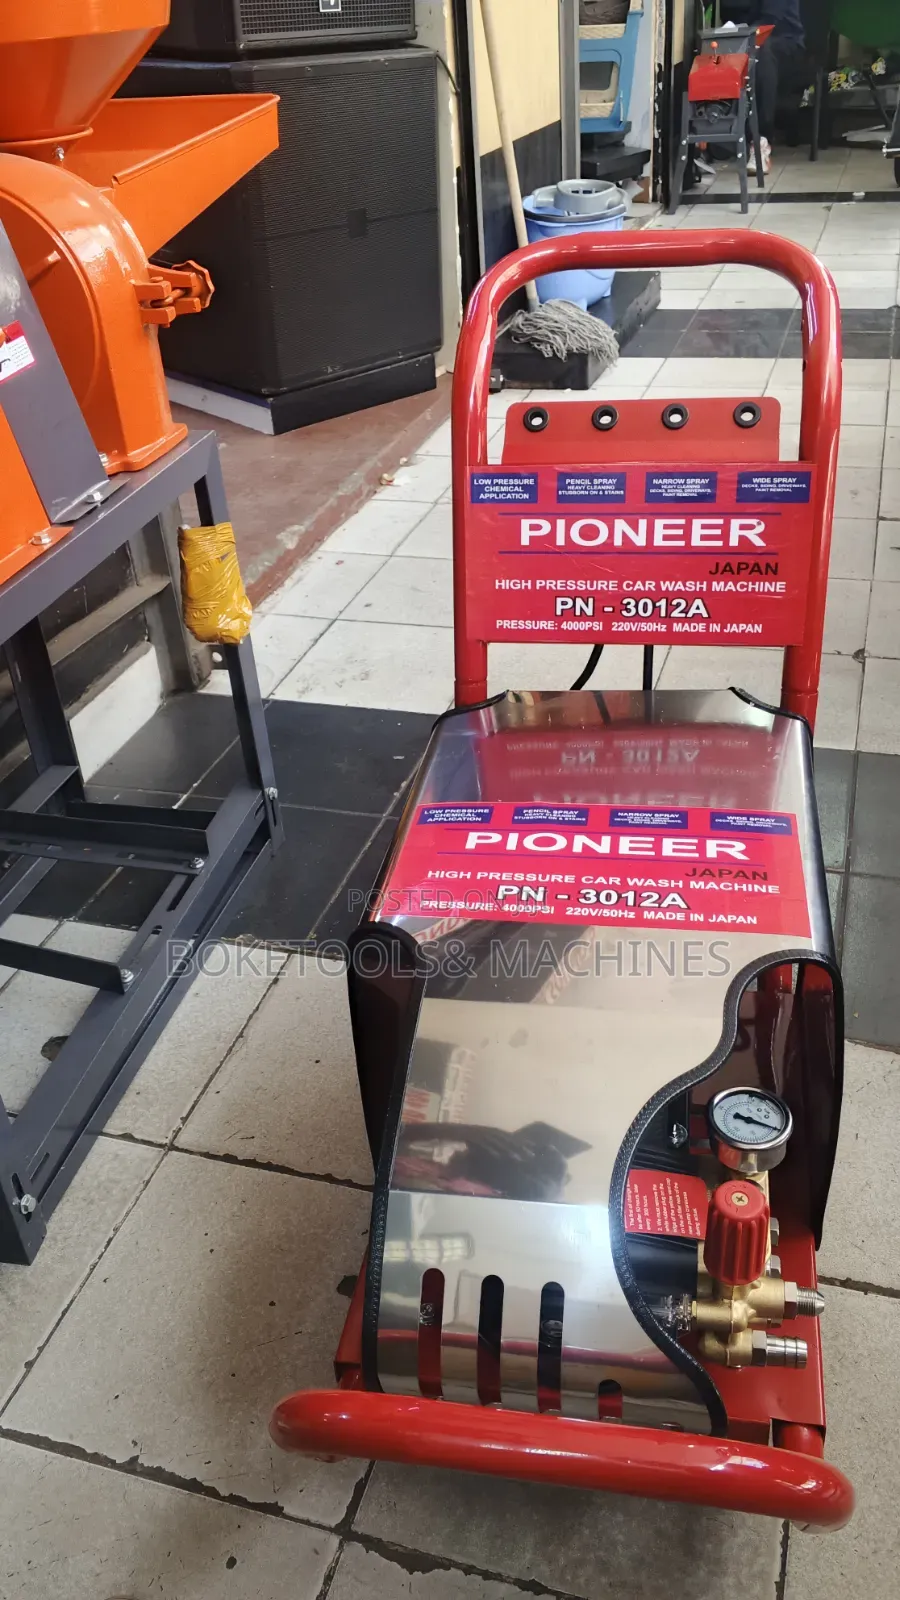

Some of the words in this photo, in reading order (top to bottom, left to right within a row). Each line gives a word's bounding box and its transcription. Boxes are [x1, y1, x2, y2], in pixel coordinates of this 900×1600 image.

[520, 518, 766, 546] PIONEER
[708, 562, 779, 576] JAPAN
[495, 579, 531, 590] HIGH
[536, 580, 618, 591] PRESSURE
[622, 580, 656, 591] CAR
[660, 581, 706, 592] WASH
[711, 582, 786, 592] MACHINE
[555, 596, 595, 616] PN
[602, 605, 615, 614] -
[620, 597, 710, 618] 3012A
[496, 620, 558, 630] PRESSURE:
[560, 621, 603, 631] 4000PSI
[611, 622, 667, 632] 220V/50Hz
[672, 623, 706, 632] MADE
[709, 623, 721, 633] IN
[723, 624, 763, 633] JAPAN
[465, 832, 750, 860] PIONEER
[427, 870, 471, 879] HIGH
[476, 872, 576, 884] PRESSURE
[581, 875, 621, 886] CAR
[627, 878, 683, 888] WASH
[689, 880, 780, 894] MACHINE
[685, 868, 768, 881] JAPAN
[496, 884, 548, 902] PN
[578, 888, 691, 910] 3012A
[420, 900, 498, 912] PRESSURE:
[566, 906, 636, 919] 220V/50Hz
[643, 911, 686, 921] MADE
[690, 912, 704, 922] IN
[708, 914, 758, 925] JAPAN
